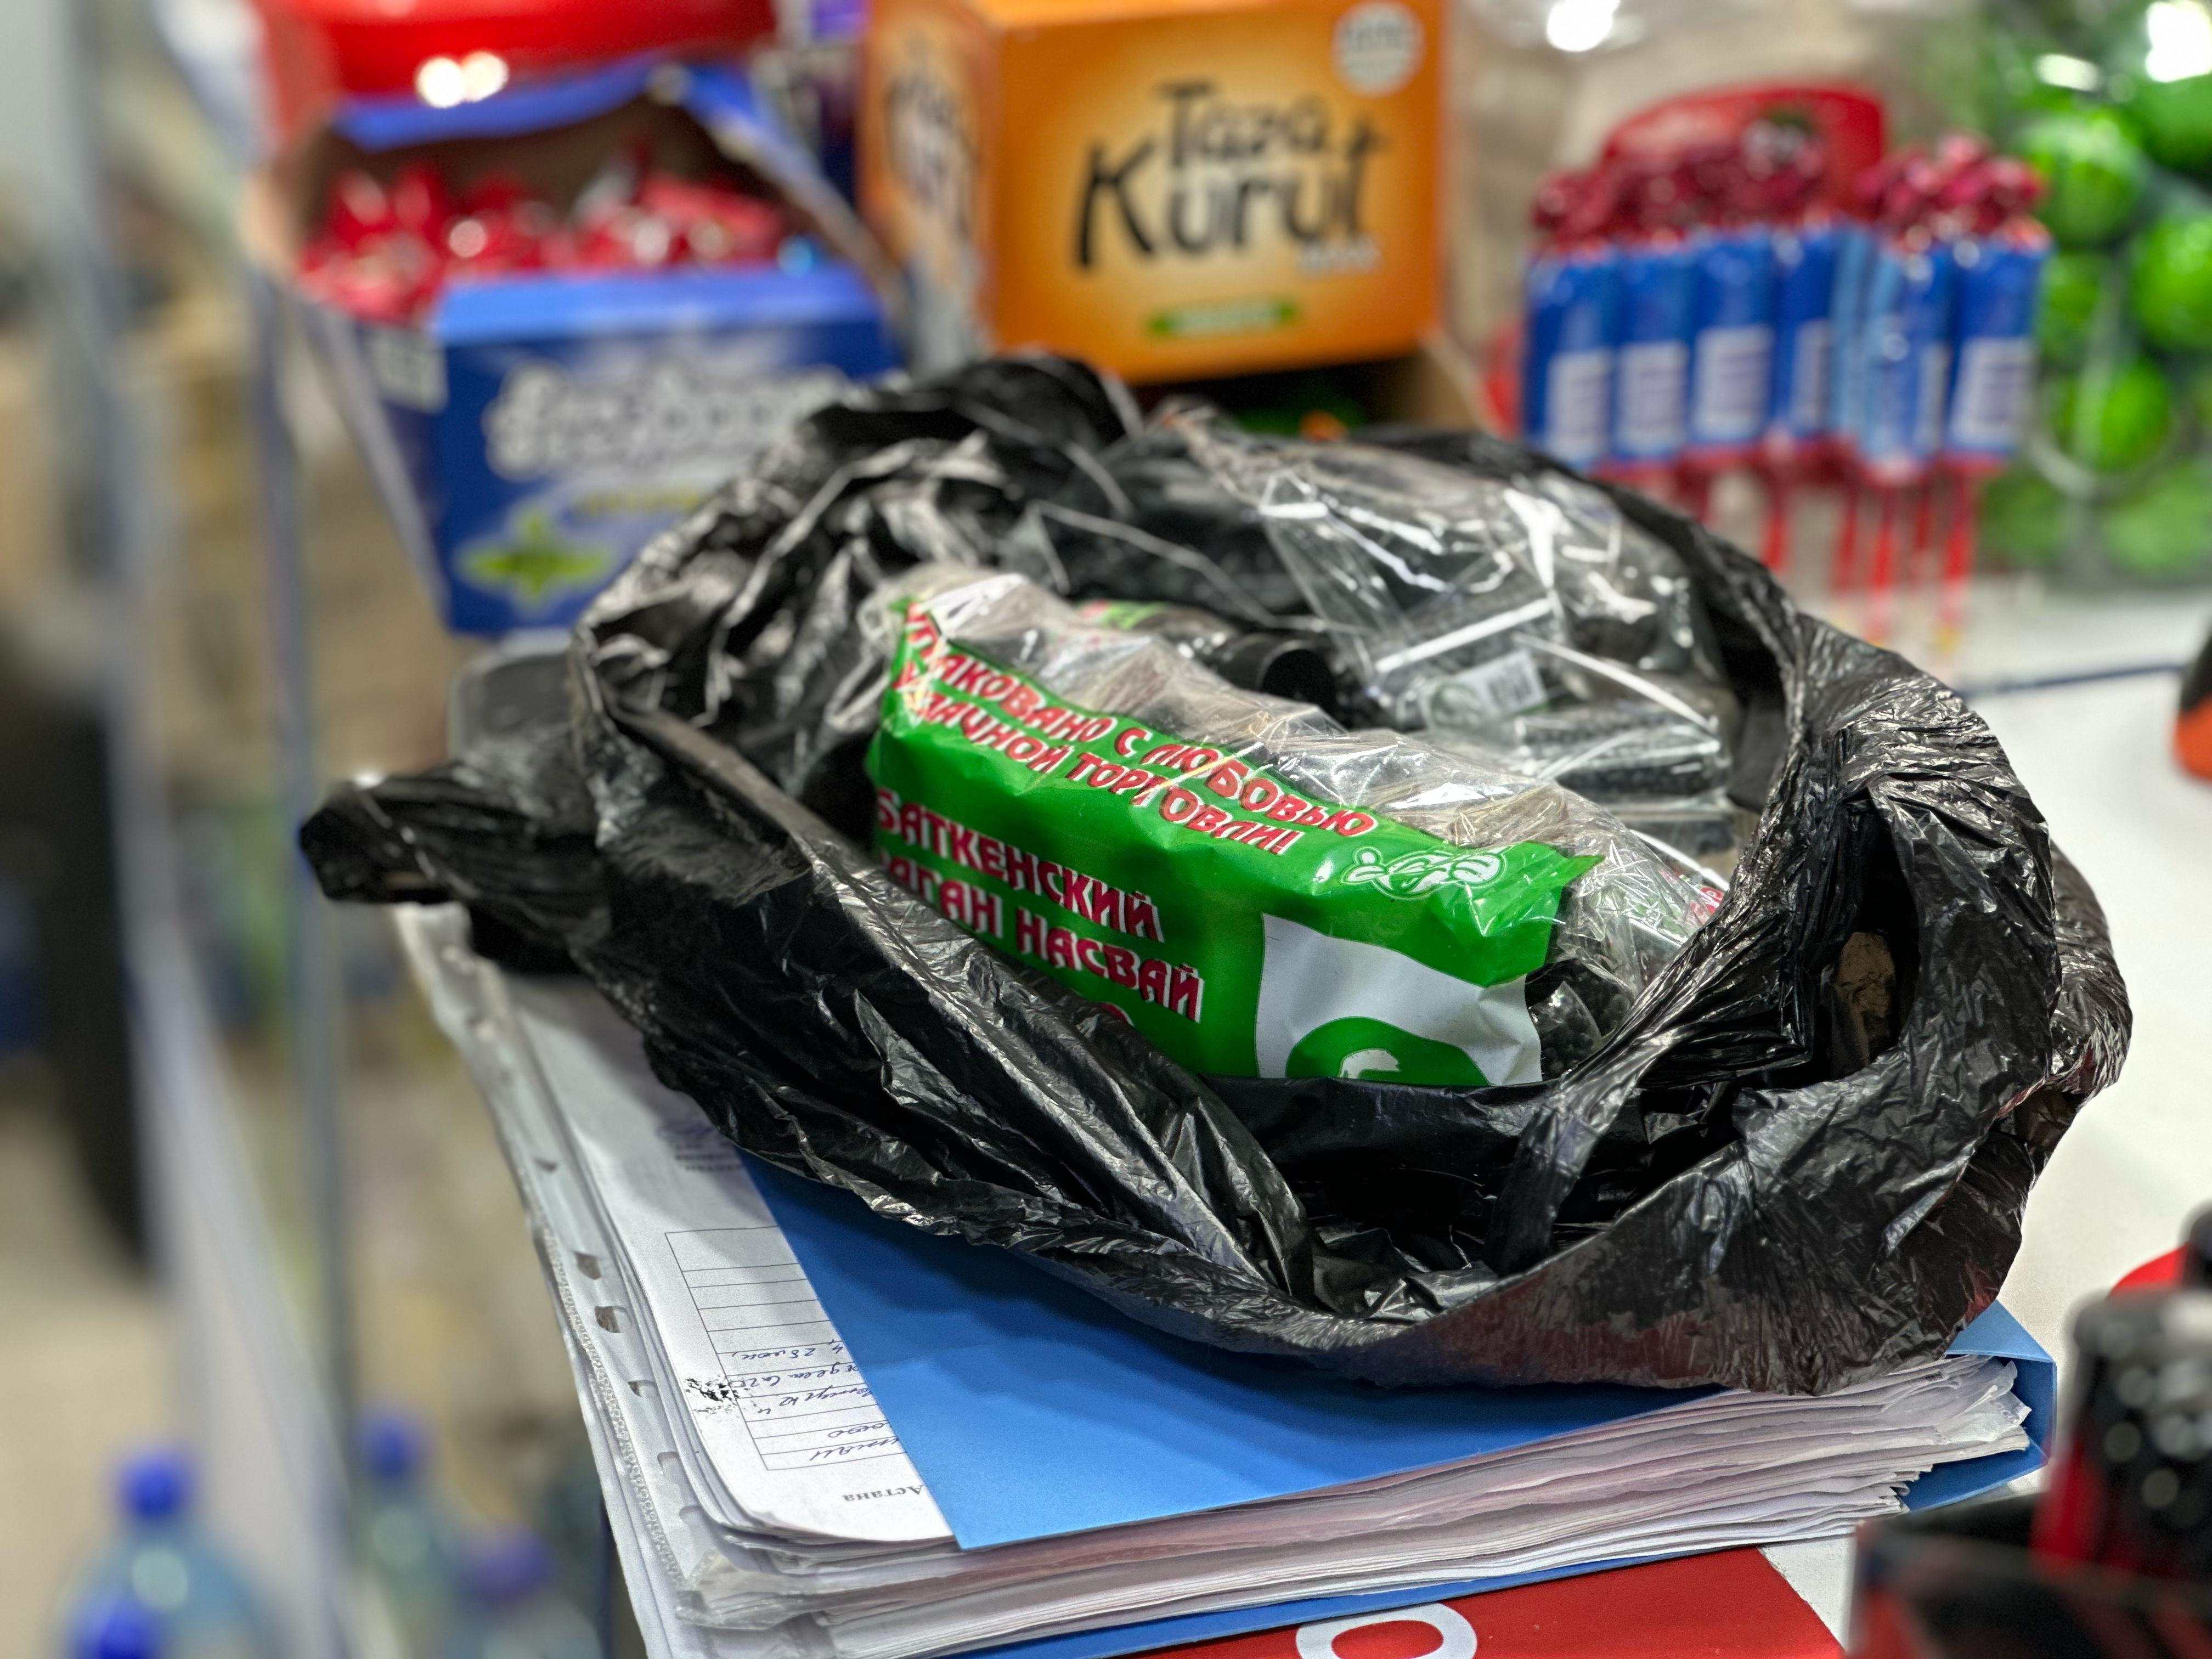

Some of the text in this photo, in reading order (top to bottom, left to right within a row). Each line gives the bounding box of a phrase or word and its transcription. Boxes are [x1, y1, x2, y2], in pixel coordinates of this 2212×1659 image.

[1075, 118, 1392, 271] Kurut
[1065, 752, 1305, 856] ТОРГОВЛИ!
[1114, 727, 1152, 758] С
[1141, 744, 1378, 837] ЛЮБОВЬЮ
[878, 786, 1164, 943] БАТКЕНСКИЙ
[879, 848, 1204, 1024] АГАН НАСВАЙ
[842, 1483, 924, 1503] Астана
